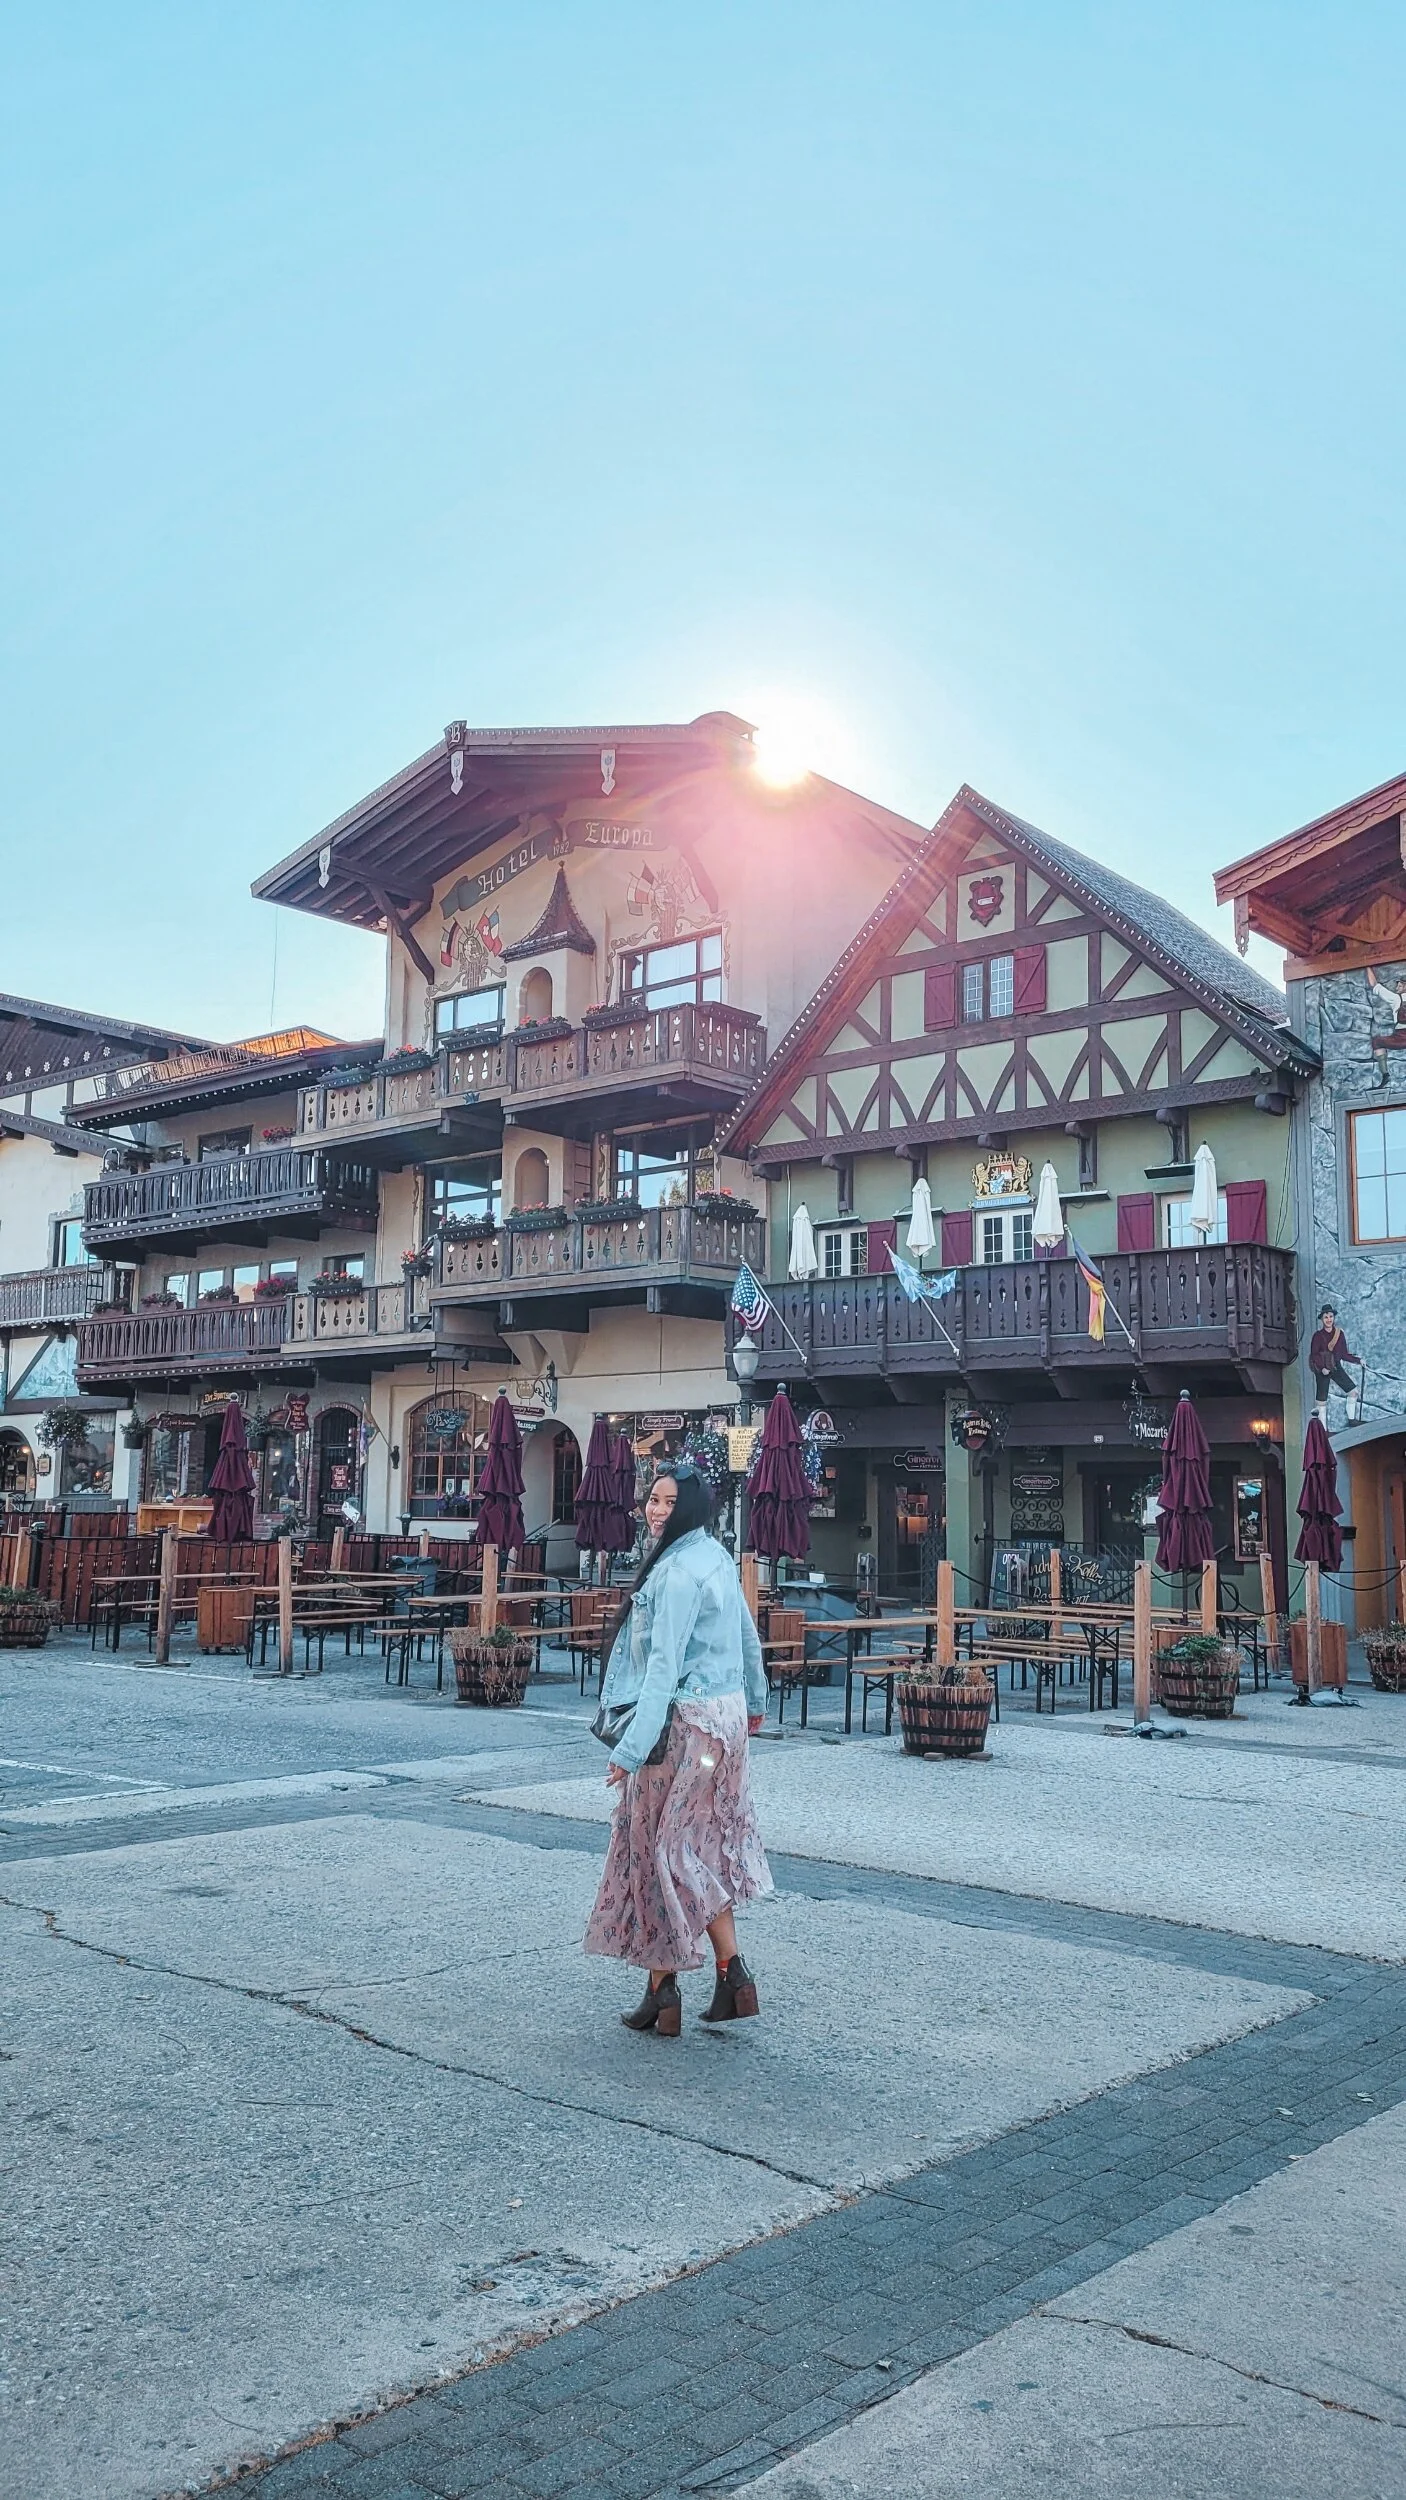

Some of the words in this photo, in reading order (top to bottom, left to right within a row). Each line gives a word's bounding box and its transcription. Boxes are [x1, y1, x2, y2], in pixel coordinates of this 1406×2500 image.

[478, 840, 538, 897] Hotel
[585, 822, 654, 848] Europa
[553, 842, 570, 856] 1982
